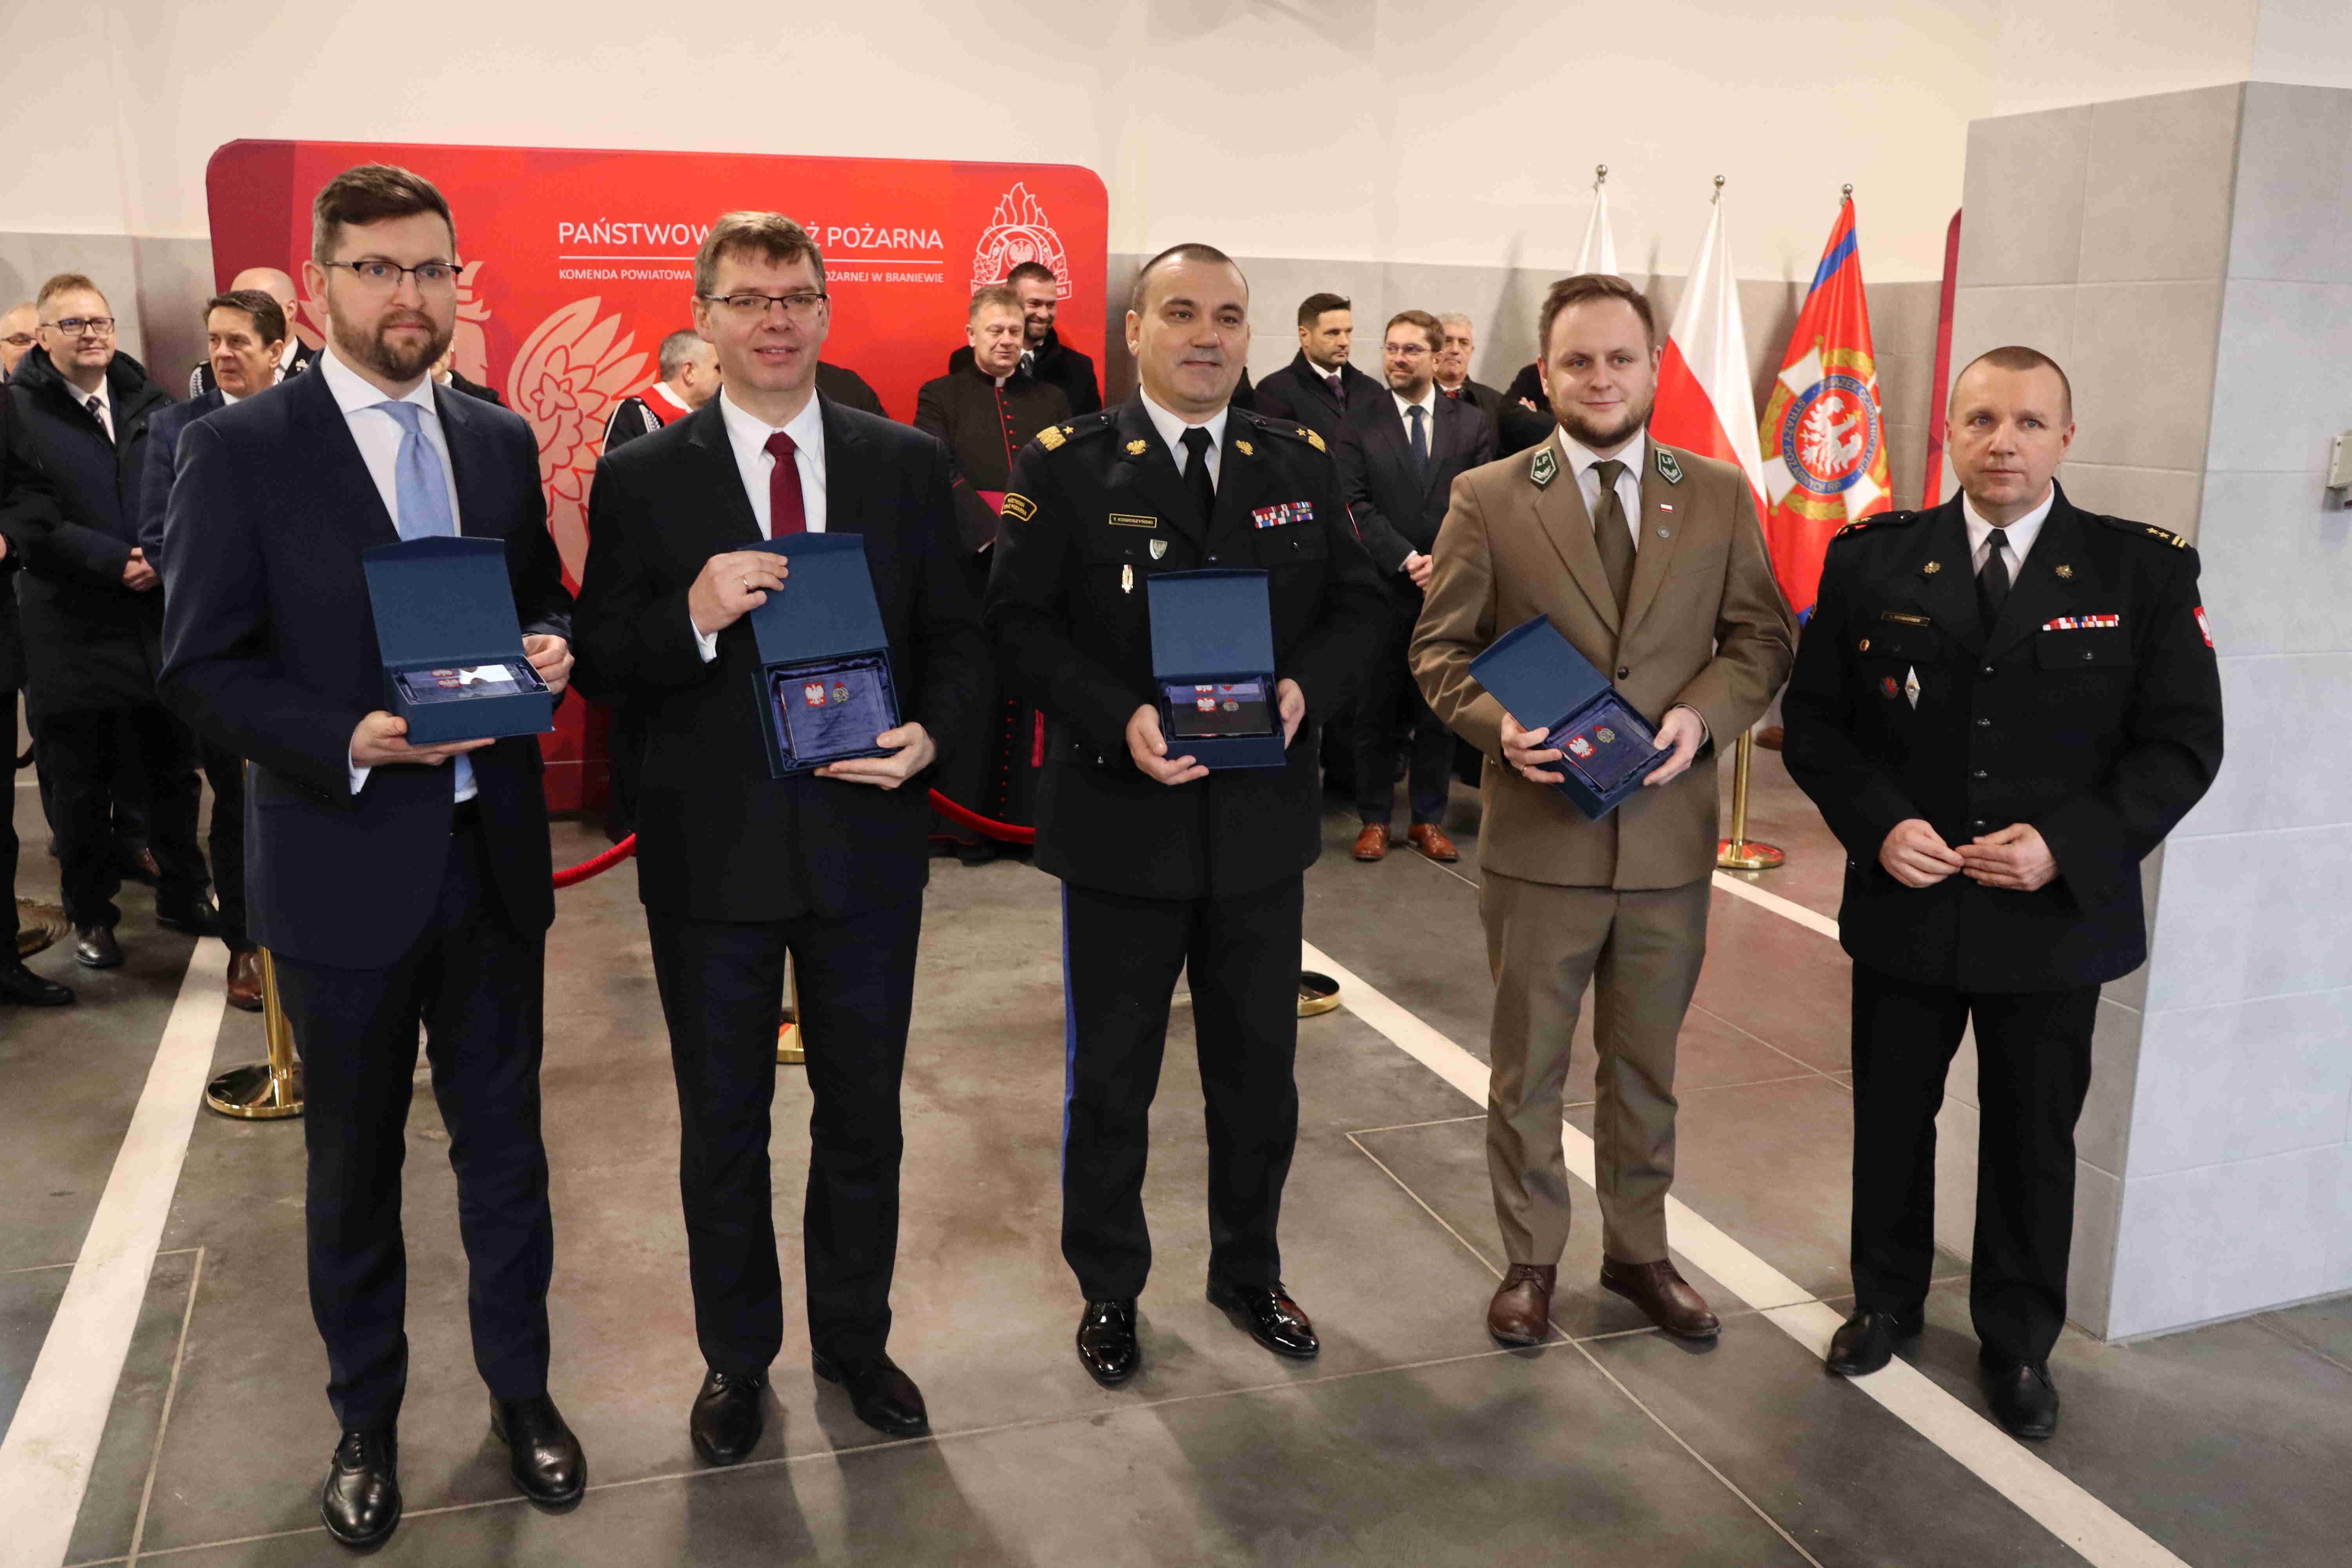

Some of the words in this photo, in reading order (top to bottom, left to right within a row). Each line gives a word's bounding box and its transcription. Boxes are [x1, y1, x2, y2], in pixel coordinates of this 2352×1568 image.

[559, 217, 711, 245] PAŃSTWOW
[827, 222, 944, 249] POŻARNA
[559, 269, 618, 280] KOMENDA
[621, 269, 693, 280] POWIATOWA
[825, 270, 869, 282] OŻARNEJ
[871, 272, 883, 282] W
[886, 272, 944, 283] BRANIEWIE
[1536, 456, 1548, 466] LP
[1661, 456, 1673, 465] LP
[1828, 481, 1841, 492] RP
